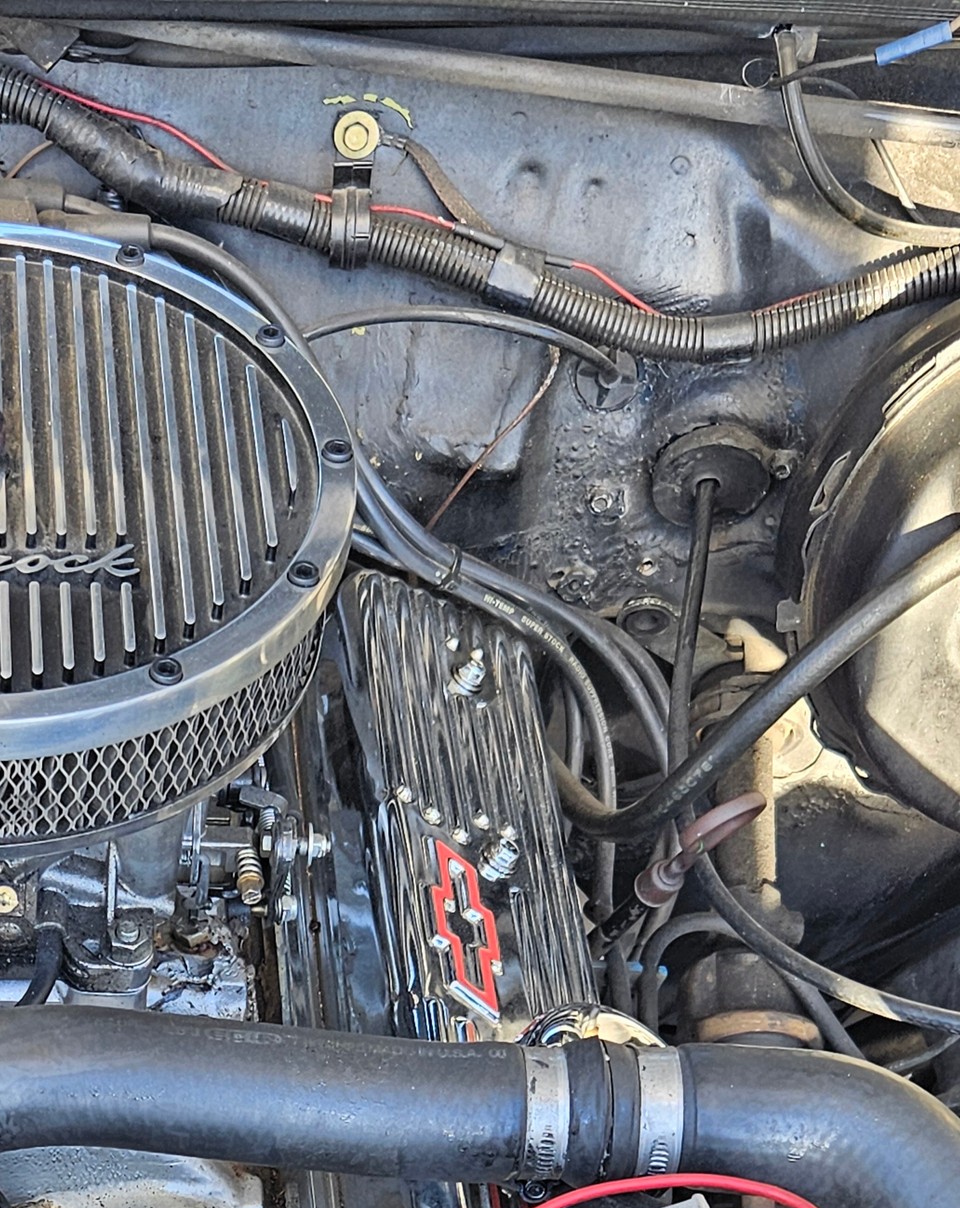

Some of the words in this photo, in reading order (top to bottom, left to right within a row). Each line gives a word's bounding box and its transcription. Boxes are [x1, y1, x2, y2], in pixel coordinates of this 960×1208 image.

[483, 593, 515, 616] HI-TEMP
[520, 615, 544, 636] SUPER
[543, 632, 566, 654] STOCK
